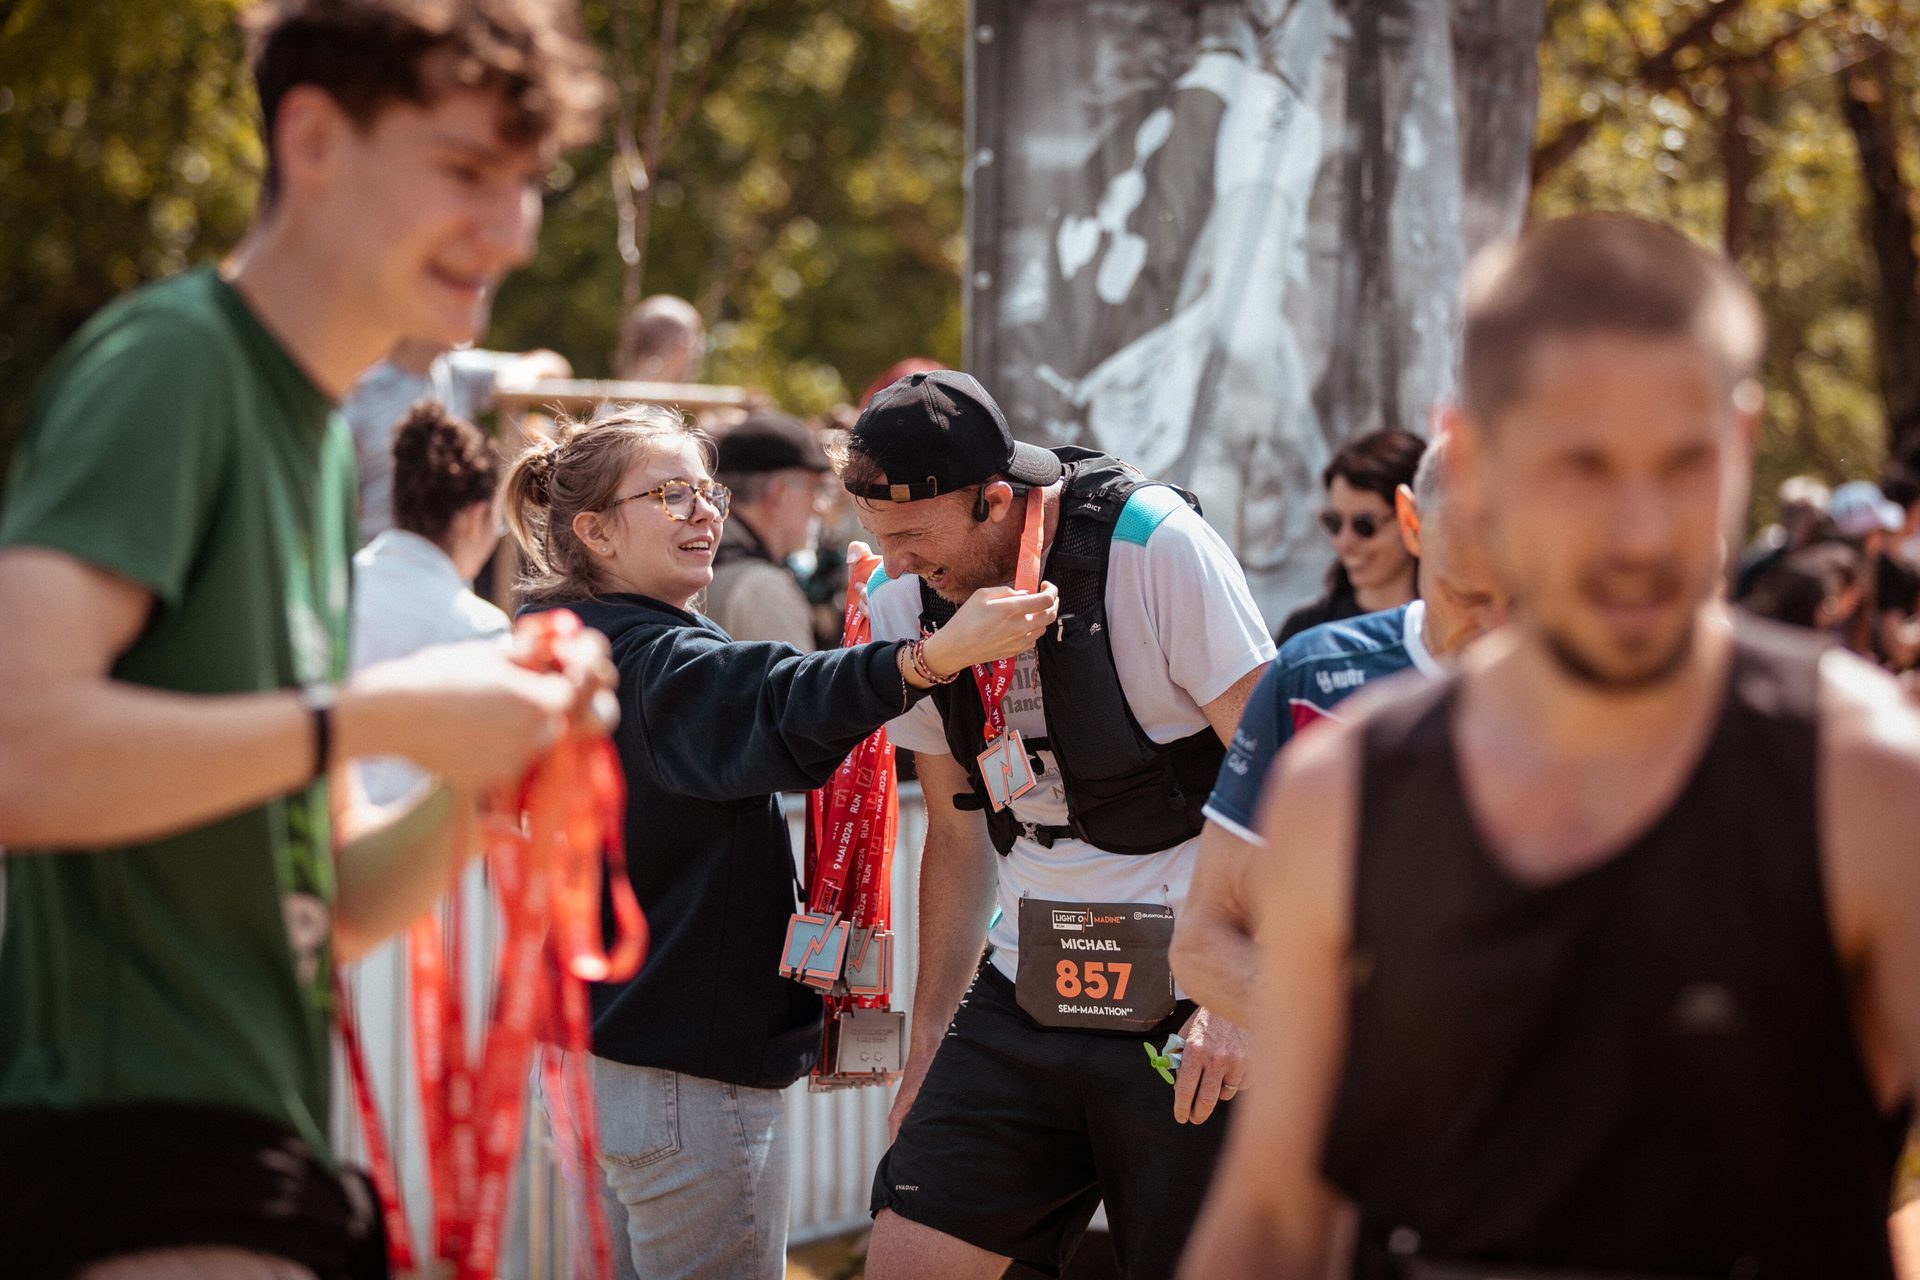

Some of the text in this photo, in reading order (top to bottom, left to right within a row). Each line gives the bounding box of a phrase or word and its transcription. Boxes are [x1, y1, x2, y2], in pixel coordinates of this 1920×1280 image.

[975, 663, 985, 677] RU
[994, 676, 1006, 697] RUN
[879, 769, 888, 794] 2024
[884, 741, 892, 755] RU
[850, 794, 863, 814] RUN
[841, 821, 854, 845] 2024
[860, 819, 870, 839] RUN
[836, 845, 848, 862] MAI
[862, 864, 872, 884] RUN
[1055, 914, 1077, 922] LIGHT
[1060, 937, 1121, 951] MICHAEL
[1055, 959, 1133, 1000] 857
